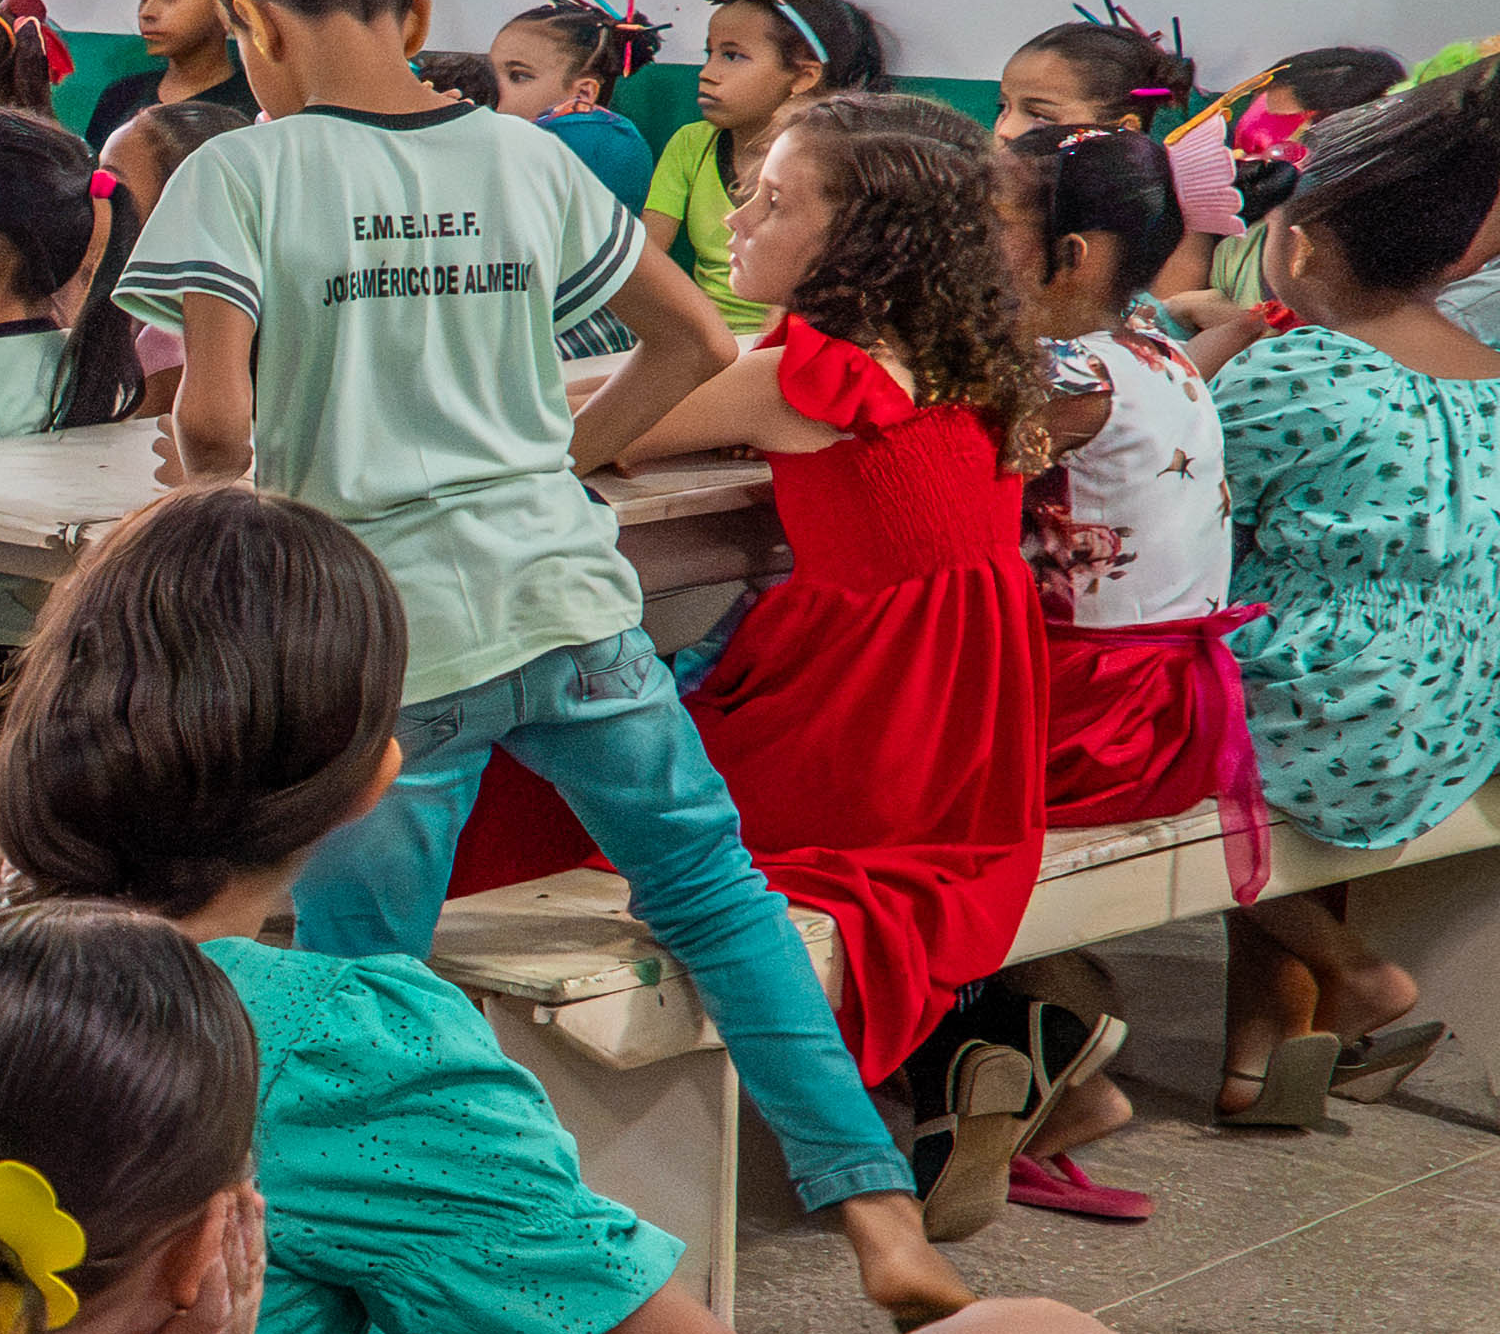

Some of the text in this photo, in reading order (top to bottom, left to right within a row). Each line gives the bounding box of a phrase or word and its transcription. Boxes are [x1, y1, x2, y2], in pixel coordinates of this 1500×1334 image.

[353, 211, 482, 241] E.M.E.I.E.F.
[434, 265, 460, 296] DE
[464, 259, 533, 295] ALMEI
